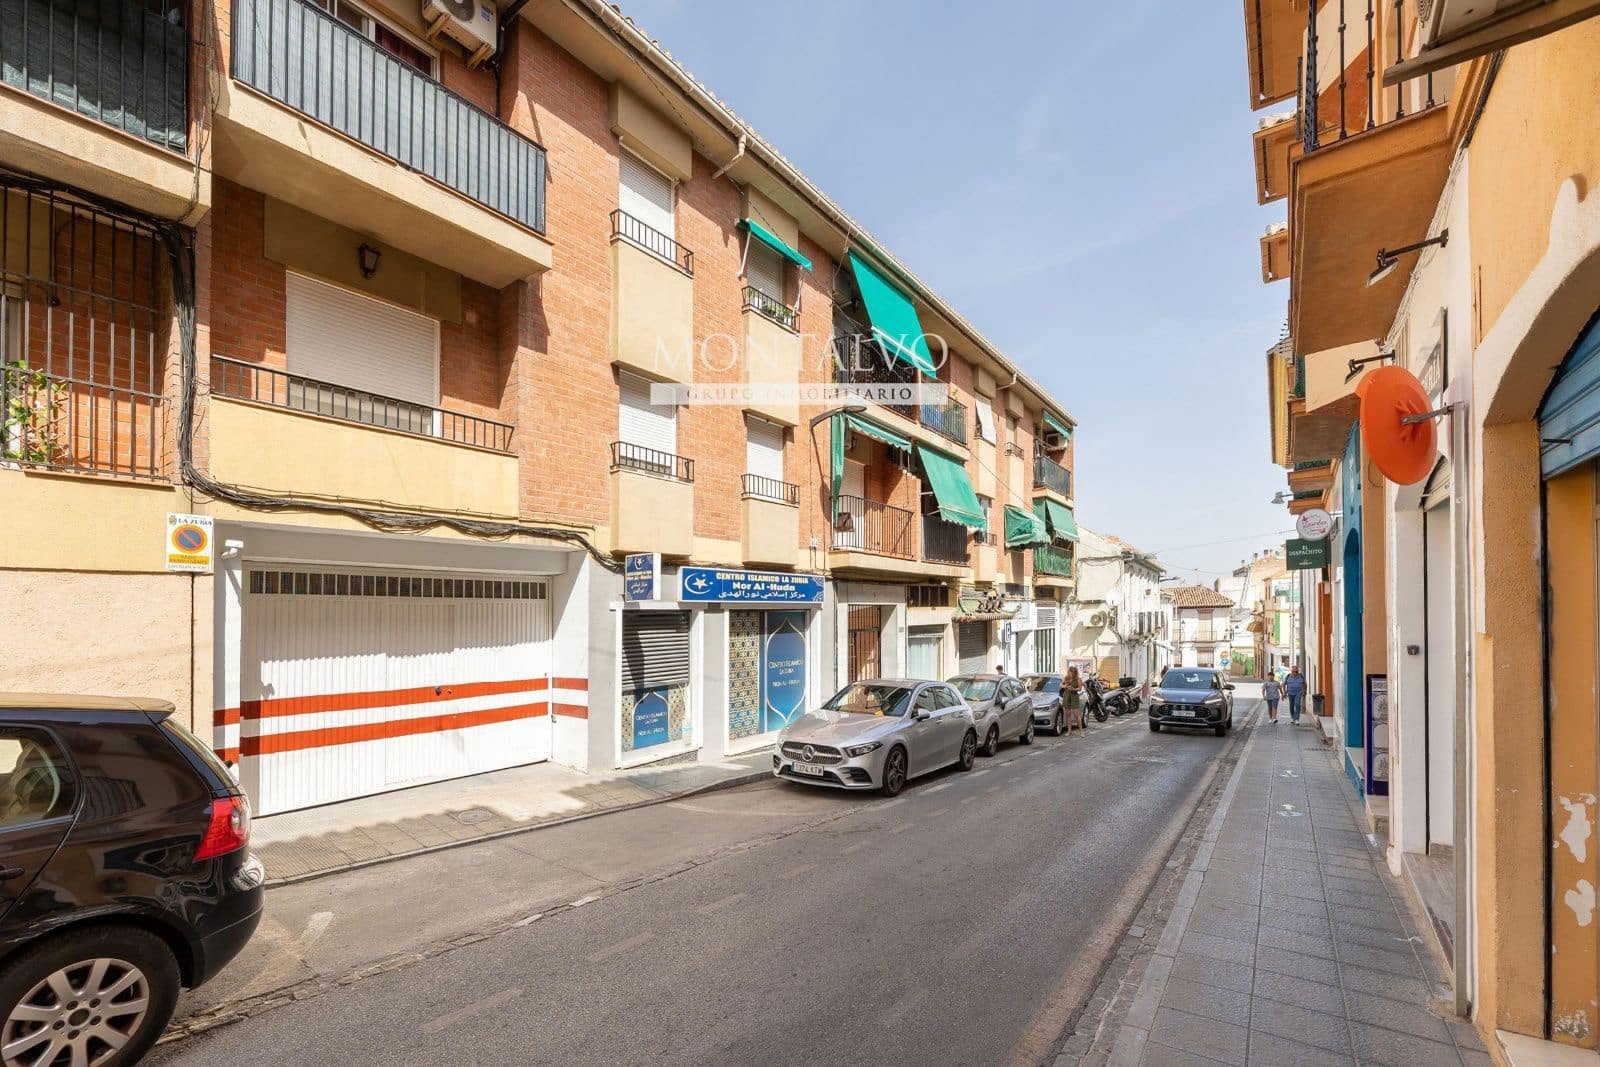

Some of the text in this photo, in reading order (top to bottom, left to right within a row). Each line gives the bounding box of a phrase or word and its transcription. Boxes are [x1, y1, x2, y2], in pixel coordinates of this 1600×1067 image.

[716, 572, 745, 581] CENTRO
[747, 573, 780, 583] ISLAMICO
[781, 575, 790, 583] LA
[732, 581, 752, 590] Nor
[753, 582, 765, 590] Al
